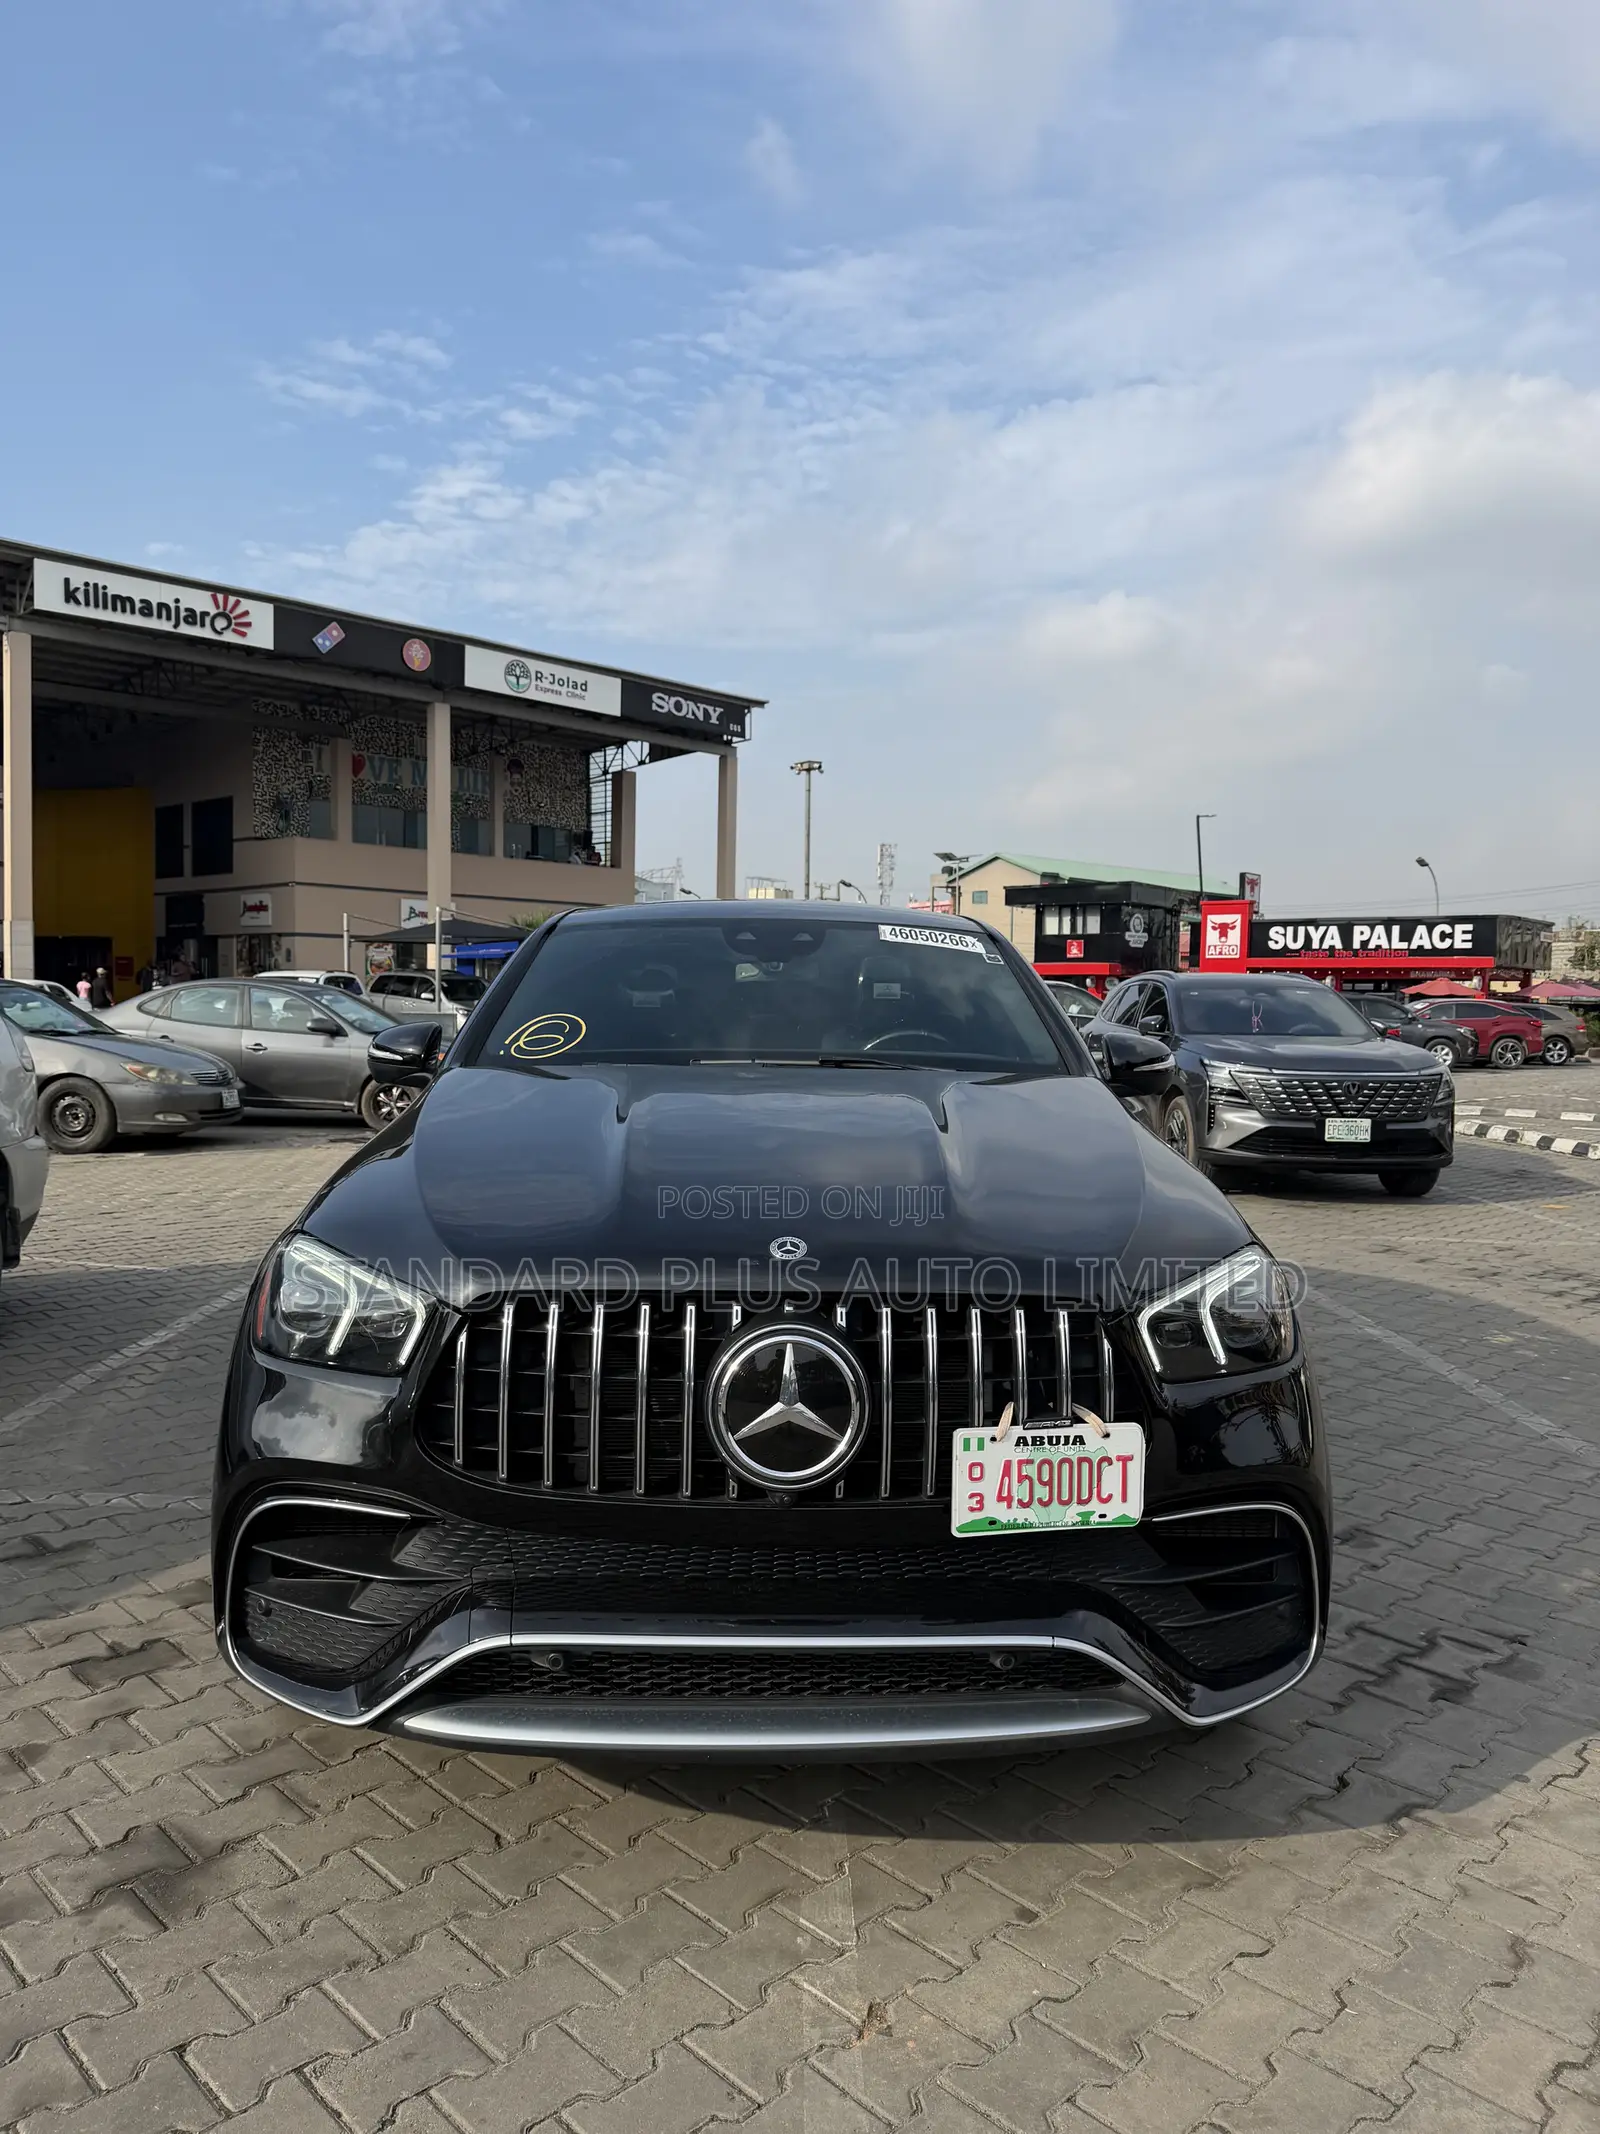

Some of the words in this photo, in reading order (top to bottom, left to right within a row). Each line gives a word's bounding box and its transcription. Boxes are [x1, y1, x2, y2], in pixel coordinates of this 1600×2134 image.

[63, 577, 233, 635] kilimanjaro
[535, 670, 588, 692] R-Jolad
[535, 684, 562, 696] Express
[566, 690, 587, 701] Clinic
[652, 692, 724, 725] SONY
[889, 926, 969, 948] 46050266
[1267, 924, 1343, 950] SUYA
[1352, 923, 1474, 950] PALACE
[1208, 945, 1238, 956] AFRO
[1334, 948, 1353, 958] the
[1358, 948, 1409, 958] tradition
[1014, 1434, 1087, 1447] ABUJA
[1014, 1446, 1047, 1454] CENTRE
[1063, 1445, 1087, 1453] UNITY
[996, 1454, 1134, 1510] 4590DCT
